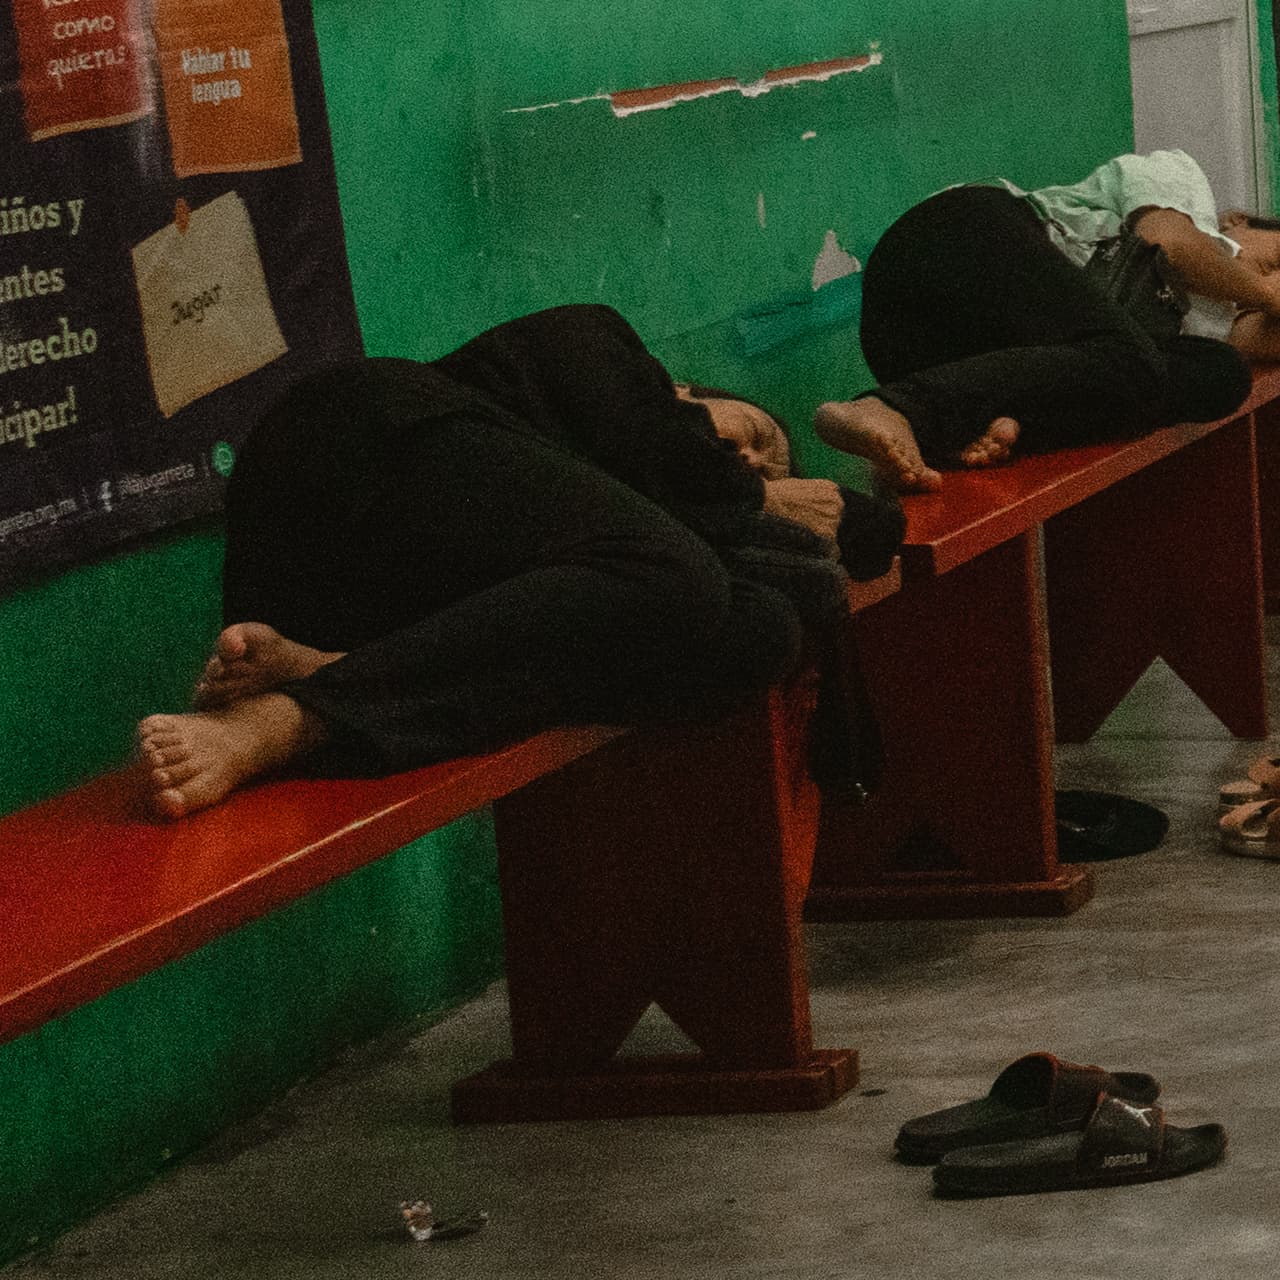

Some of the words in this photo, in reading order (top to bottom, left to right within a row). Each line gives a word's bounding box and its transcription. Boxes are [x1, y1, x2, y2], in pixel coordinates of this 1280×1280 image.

[53, 14, 116, 41] como
[47, 44, 127, 92] quieras
[66, 197, 85, 236] y
